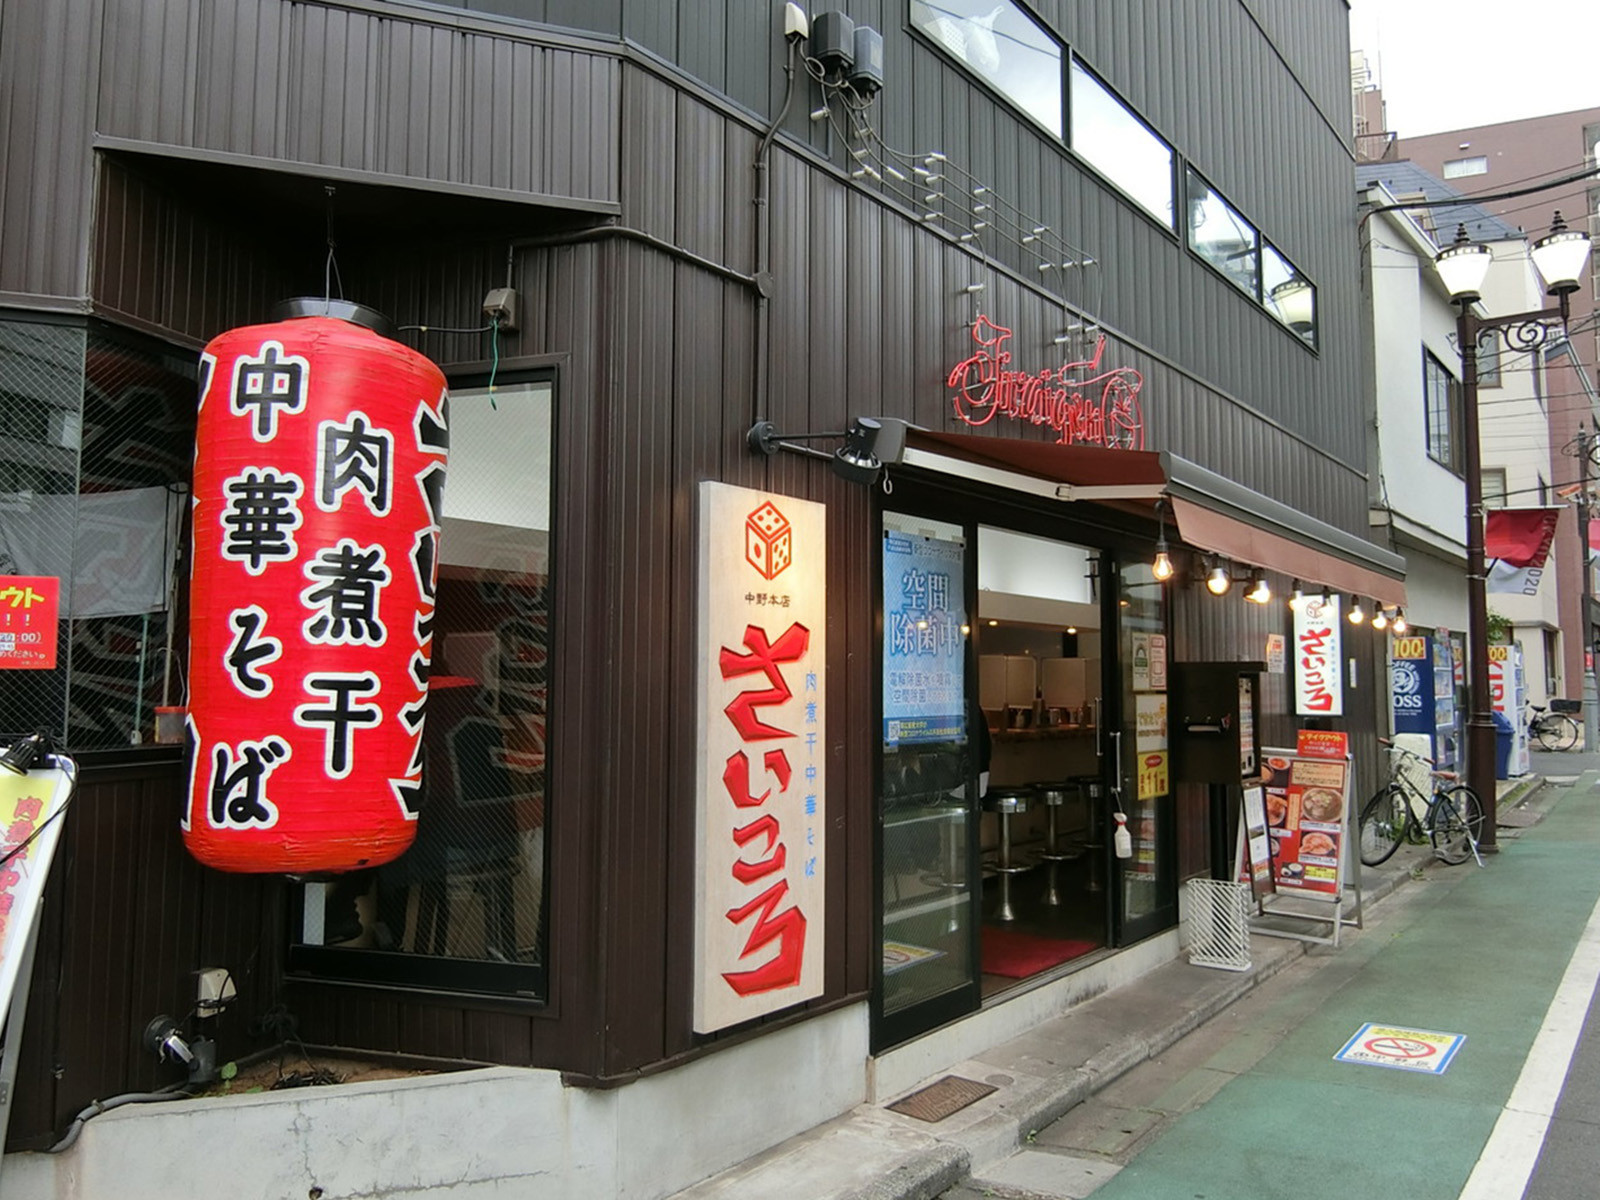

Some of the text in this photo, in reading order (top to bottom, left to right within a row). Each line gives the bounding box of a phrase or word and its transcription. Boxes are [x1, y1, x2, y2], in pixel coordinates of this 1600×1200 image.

[209, 342, 308, 828] 中華そば
[296, 413, 393, 777] 肉煮干
[745, 591, 791, 608] 中野本店
[889, 612, 960, 657] 除菌中
[902, 569, 949, 613] 空間
[1299, 627, 1334, 711] さいころ
[719, 620, 811, 998] さいころ
[804, 670, 817, 878] 肉煮干中華そば
